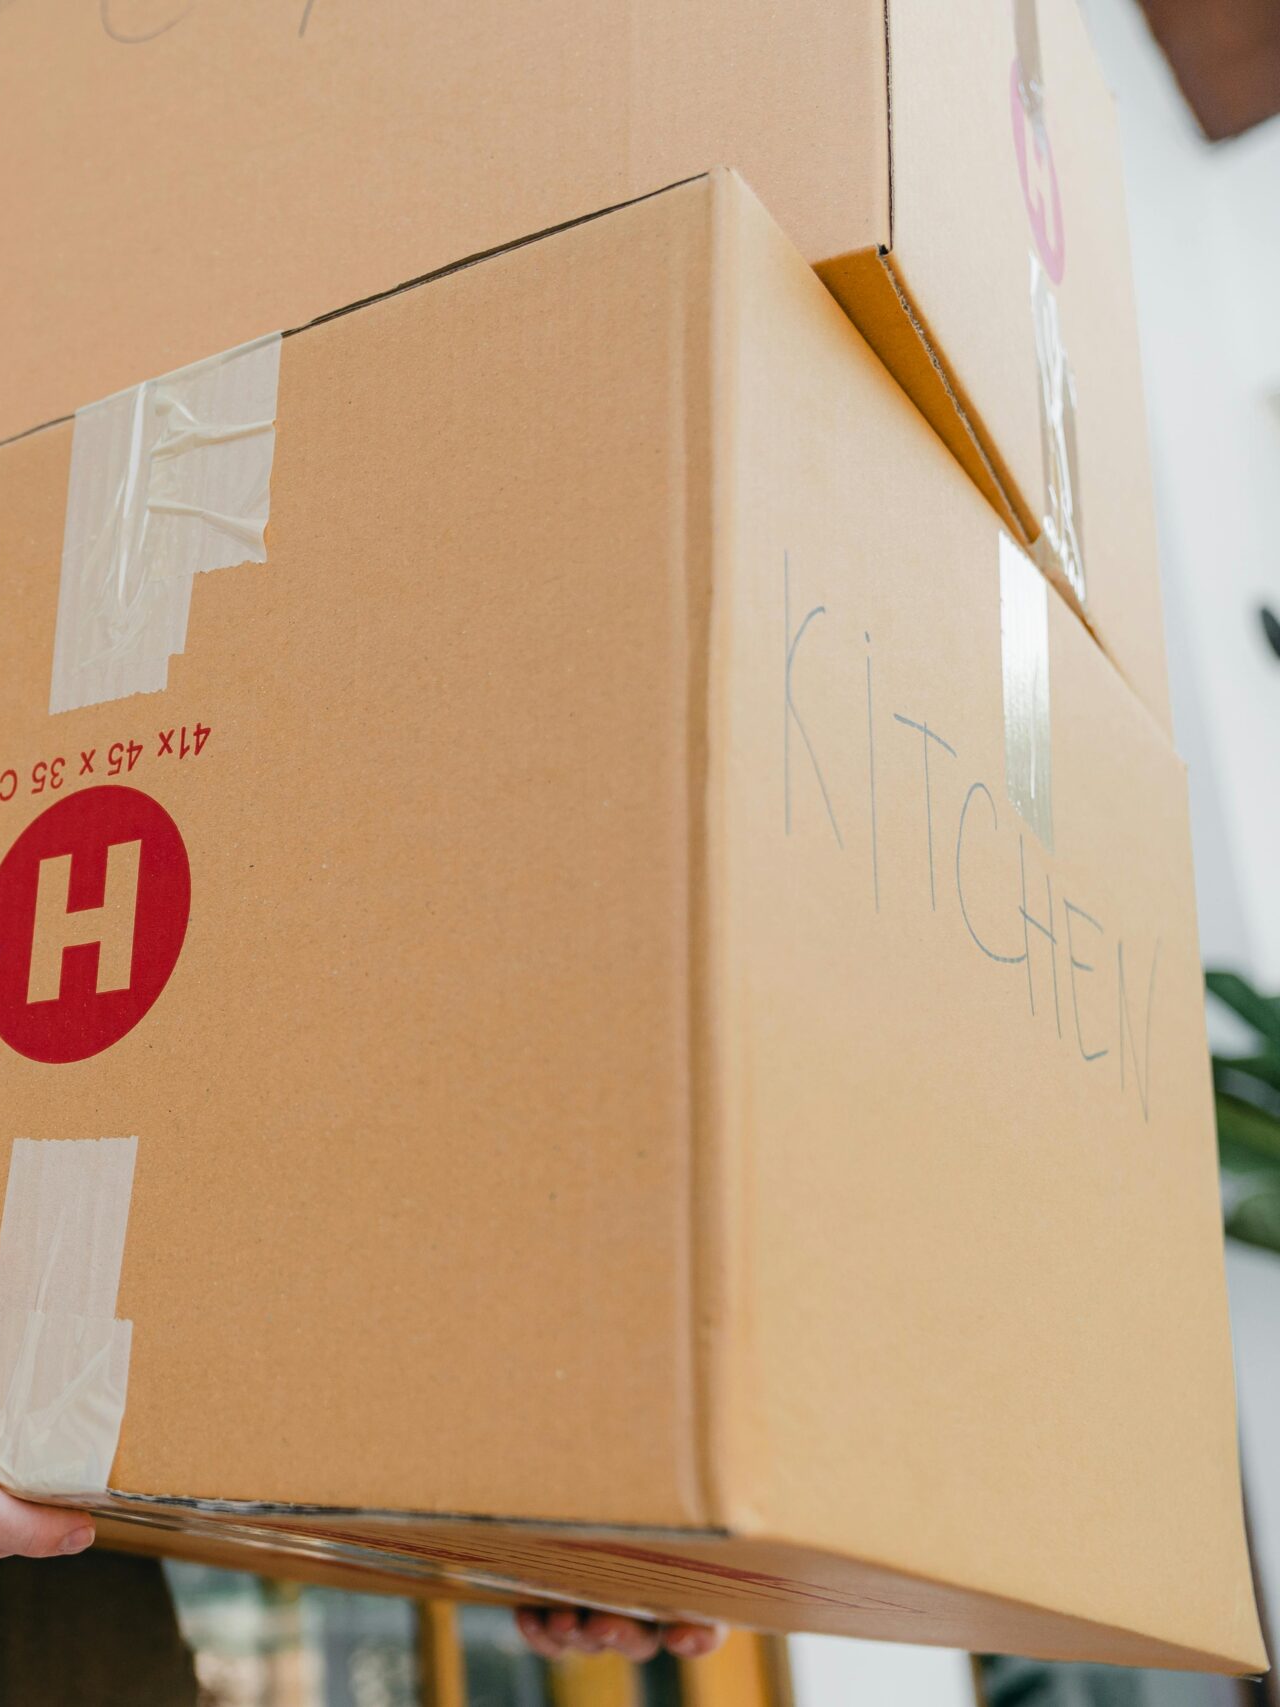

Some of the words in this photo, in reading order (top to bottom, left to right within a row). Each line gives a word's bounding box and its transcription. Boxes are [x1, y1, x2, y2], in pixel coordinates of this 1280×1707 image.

[107, 739, 144, 776] 45
[157, 722, 212, 760] 41x
[31, 757, 66, 795] 35
[79, 749, 97, 776] x
[26, 838, 143, 1005] H
